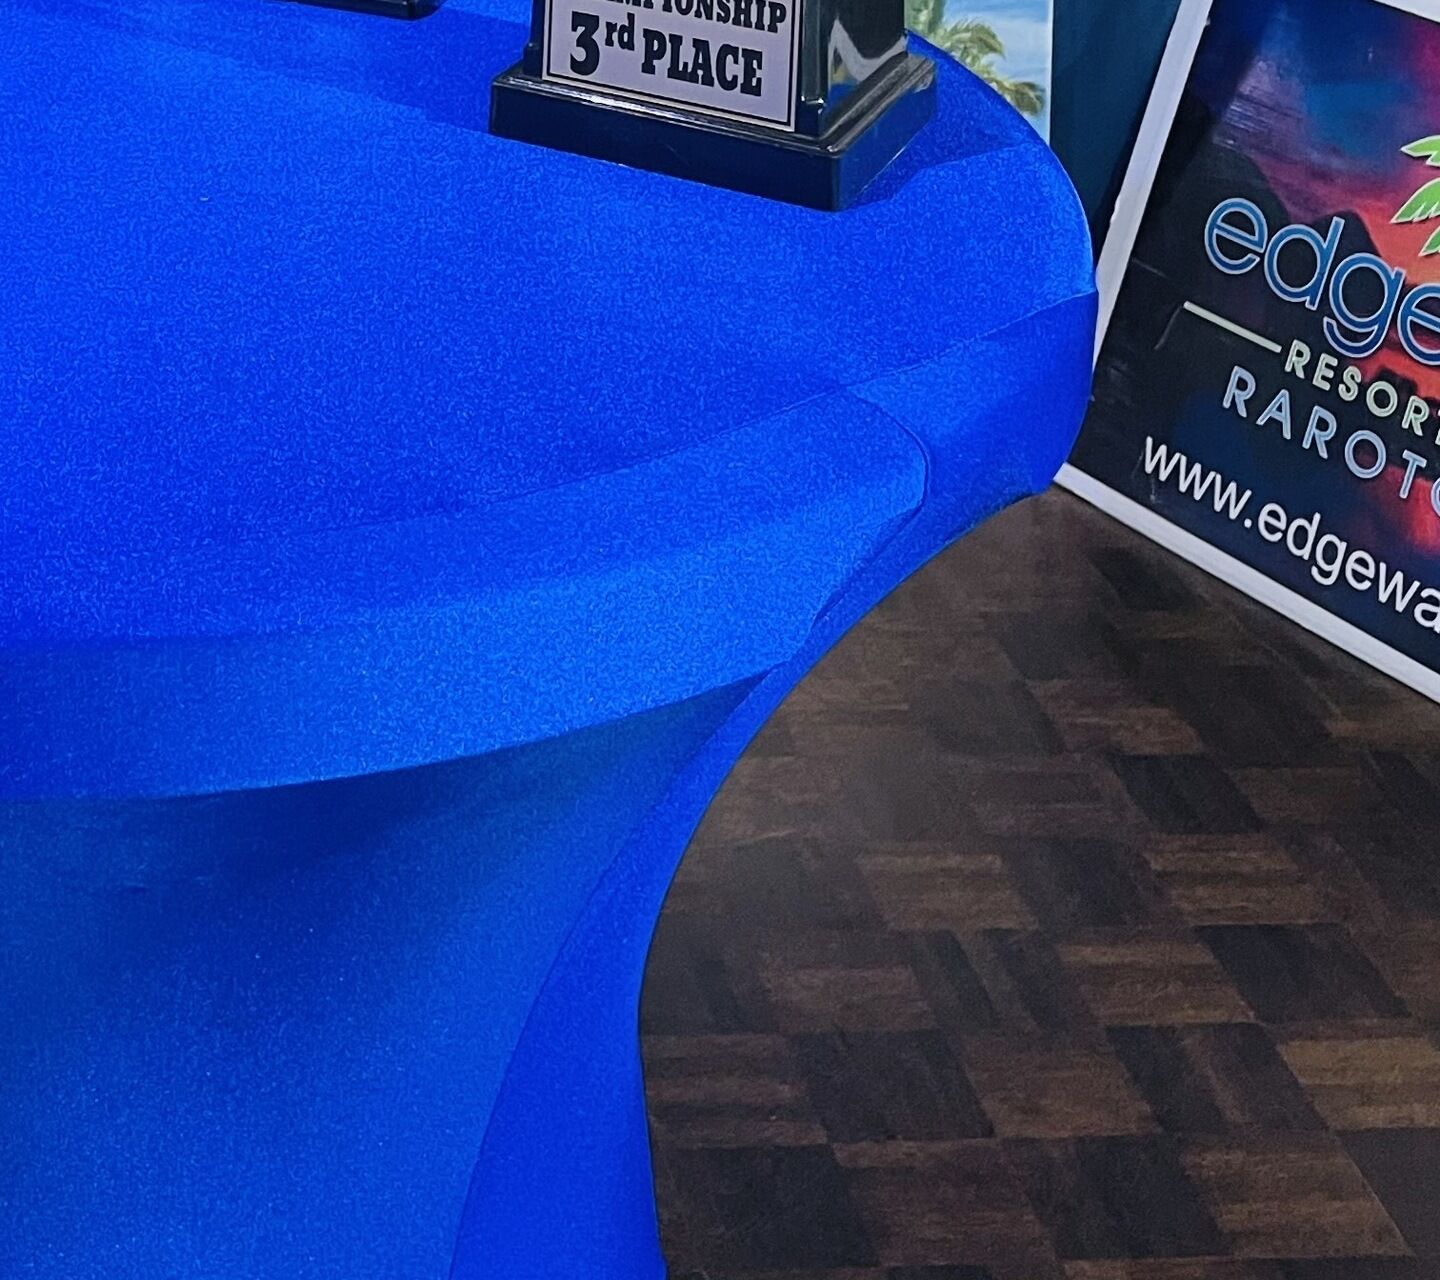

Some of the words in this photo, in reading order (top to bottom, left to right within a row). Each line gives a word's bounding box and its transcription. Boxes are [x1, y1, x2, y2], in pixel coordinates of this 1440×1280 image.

[570, 10, 635, 76] 3rd
[641, 28, 763, 97] PLACE
[1204, 197, 1440, 365] edge
[1222, 365, 1440, 517] RAROT
[1284, 339, 1440, 446] RESOR
[1144, 436, 1440, 634] www.edgewa
